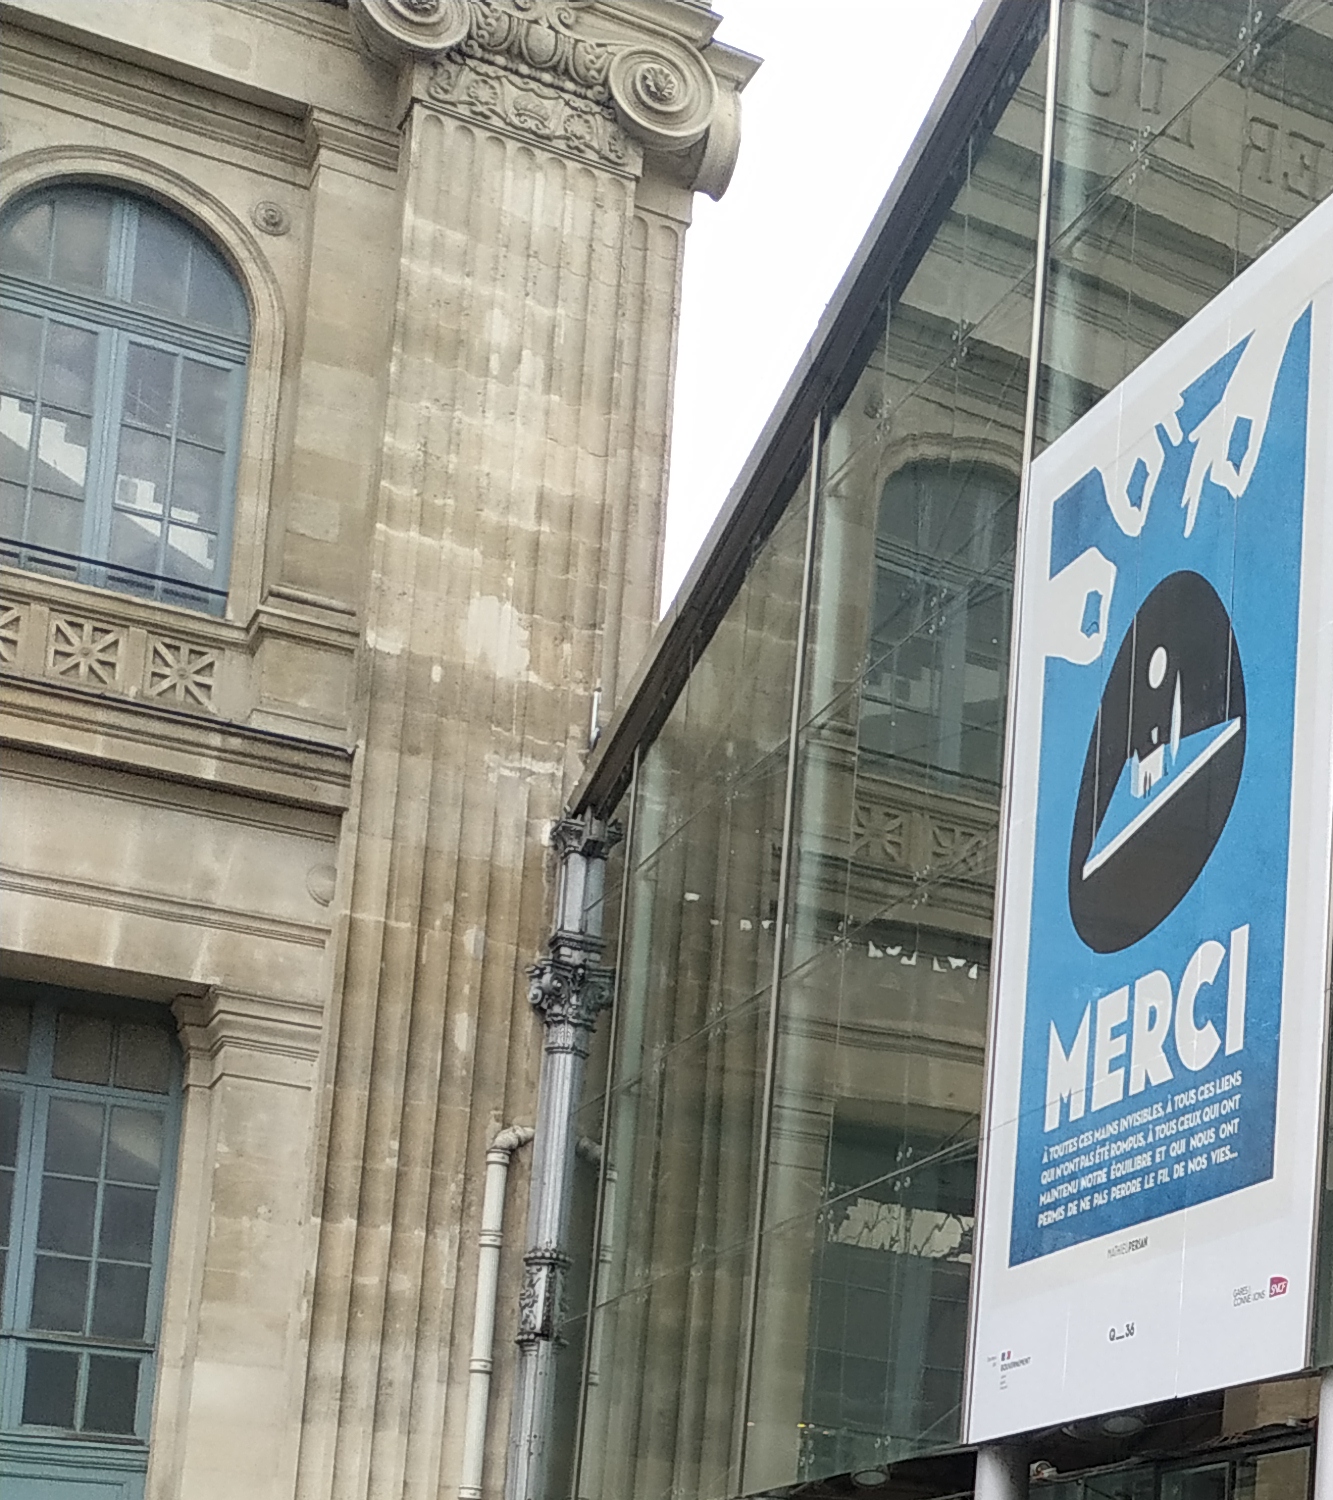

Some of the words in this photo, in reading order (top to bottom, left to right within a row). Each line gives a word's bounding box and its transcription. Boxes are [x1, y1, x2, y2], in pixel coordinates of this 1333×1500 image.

[1044, 923, 1249, 1133] MERCI
[1041, 1167, 1055, 1185] QUI
[1080, 1154, 1094, 1173] PAS
[1095, 1142, 1110, 1167] ÉTÉ
[1110, 1132, 1146, 1161] ROMPUS,
[1155, 1120, 1177, 1140] TOUS
[1178, 1112, 1201, 1133] CEUX
[1202, 1102, 1220, 1125] QUI
[1220, 1094, 1241, 1116] ONT
[1050, 1137, 1078, 1160] TOUTES
[1079, 1131, 1093, 1147] CES
[1094, 1120, 1119, 1142] MAINS
[1120, 1102, 1165, 1131] INVISIBLES,
[1174, 1089, 1196, 1110] TOUS
[1198, 1082, 1215, 1100] CES
[1216, 1070, 1243, 1094] LIENS
[1037, 1205, 1065, 1228] PERMIS
[1067, 1200, 1079, 1217] DE
[1079, 1195, 1091, 1213] NE
[1092, 1189, 1108, 1208] PAS
[1110, 1178, 1142, 1201] PERDRE
[1144, 1173, 1155, 1190] LE
[1157, 1167, 1170, 1185] FIL
[1173, 1162, 1185, 1179] DE
[1187, 1153, 1208, 1175] NOS
[1039, 1179, 1079, 1207] MAINTENU
[1080, 1168, 1107, 1191] NOTRE
[1110, 1151, 1152, 1180] ÉQUILIBRE
[1155, 1146, 1166, 1163] ET
[1169, 1138, 1186, 1158] QUI
[1190, 1126, 1216, 1150] NOUS
[1219, 1118, 1240, 1139] ONT
